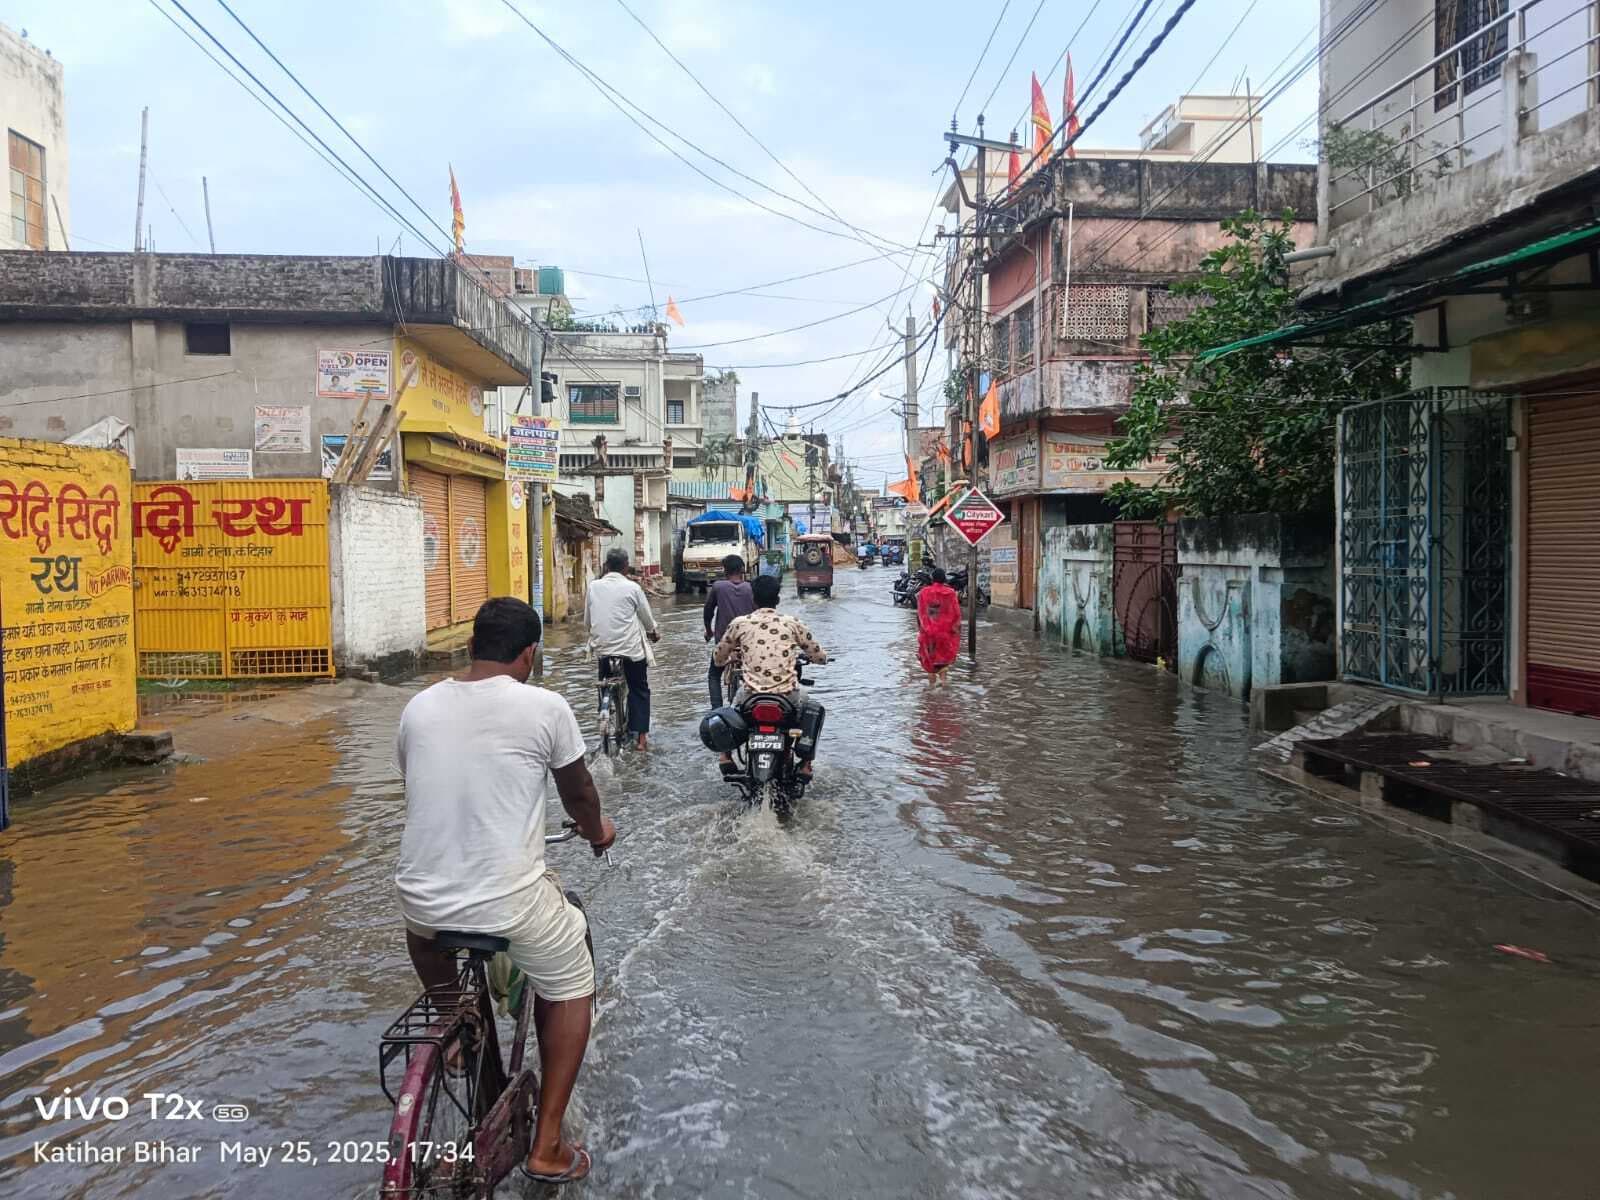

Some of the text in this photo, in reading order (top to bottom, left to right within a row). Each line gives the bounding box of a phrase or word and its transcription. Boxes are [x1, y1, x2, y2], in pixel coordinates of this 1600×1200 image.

[355, 358, 388, 366] OPEN
[212, 497, 312, 537] रथ
[966, 511, 994, 519] Citykart
[30, 555, 82, 594] रथ
